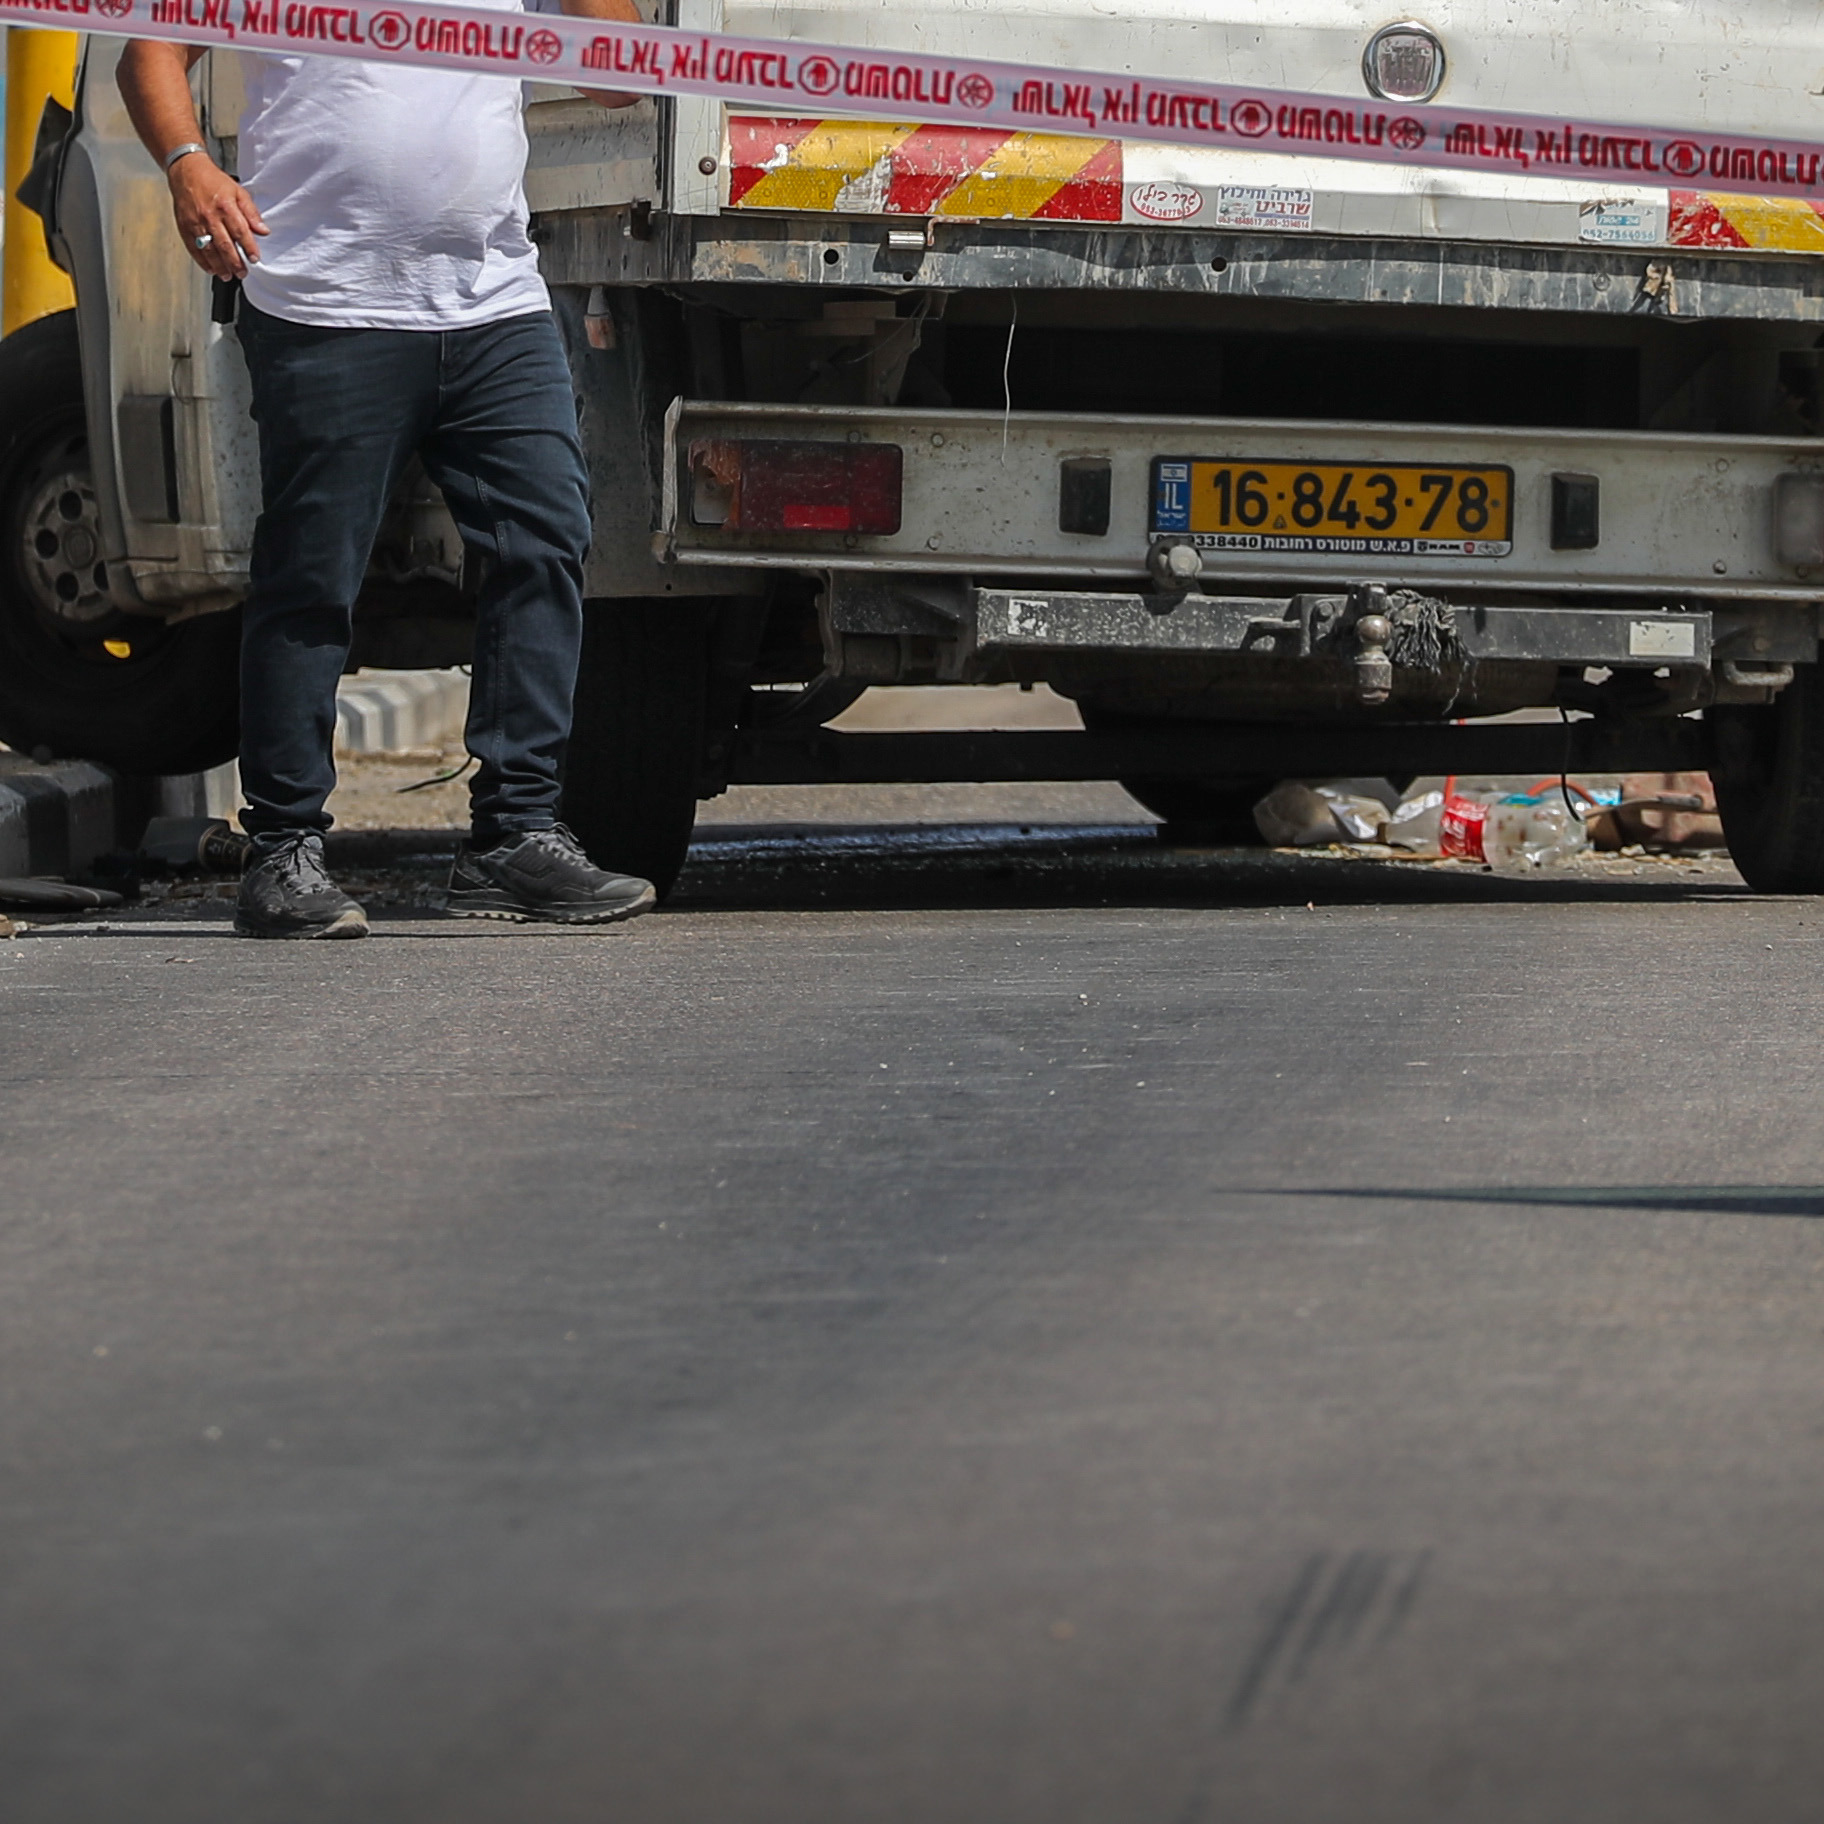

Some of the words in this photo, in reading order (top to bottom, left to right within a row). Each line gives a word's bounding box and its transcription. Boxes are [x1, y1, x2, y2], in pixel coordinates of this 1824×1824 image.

[285, 3, 365, 44] מעבר
[415, 17, 524, 60] משטרת
[582, 36, 666, 85] ישראל
[671, 39, 709, 80] אין
[715, 49, 795, 89] מעבר
[845, 62, 956, 104] משטרת
[1012, 80, 1097, 128] ישראל
[1102, 83, 1140, 123] אין
[1146, 92, 1227, 132] מעבר
[1279, 105, 1386, 146] משטרת
[1445, 122, 1529, 169] ישראל
[1535, 125, 1572, 164] אין
[1579, 133, 1660, 172] מעבר
[1709, 145, 1821, 186] משטרת
[1164, 483, 1184, 510] IL
